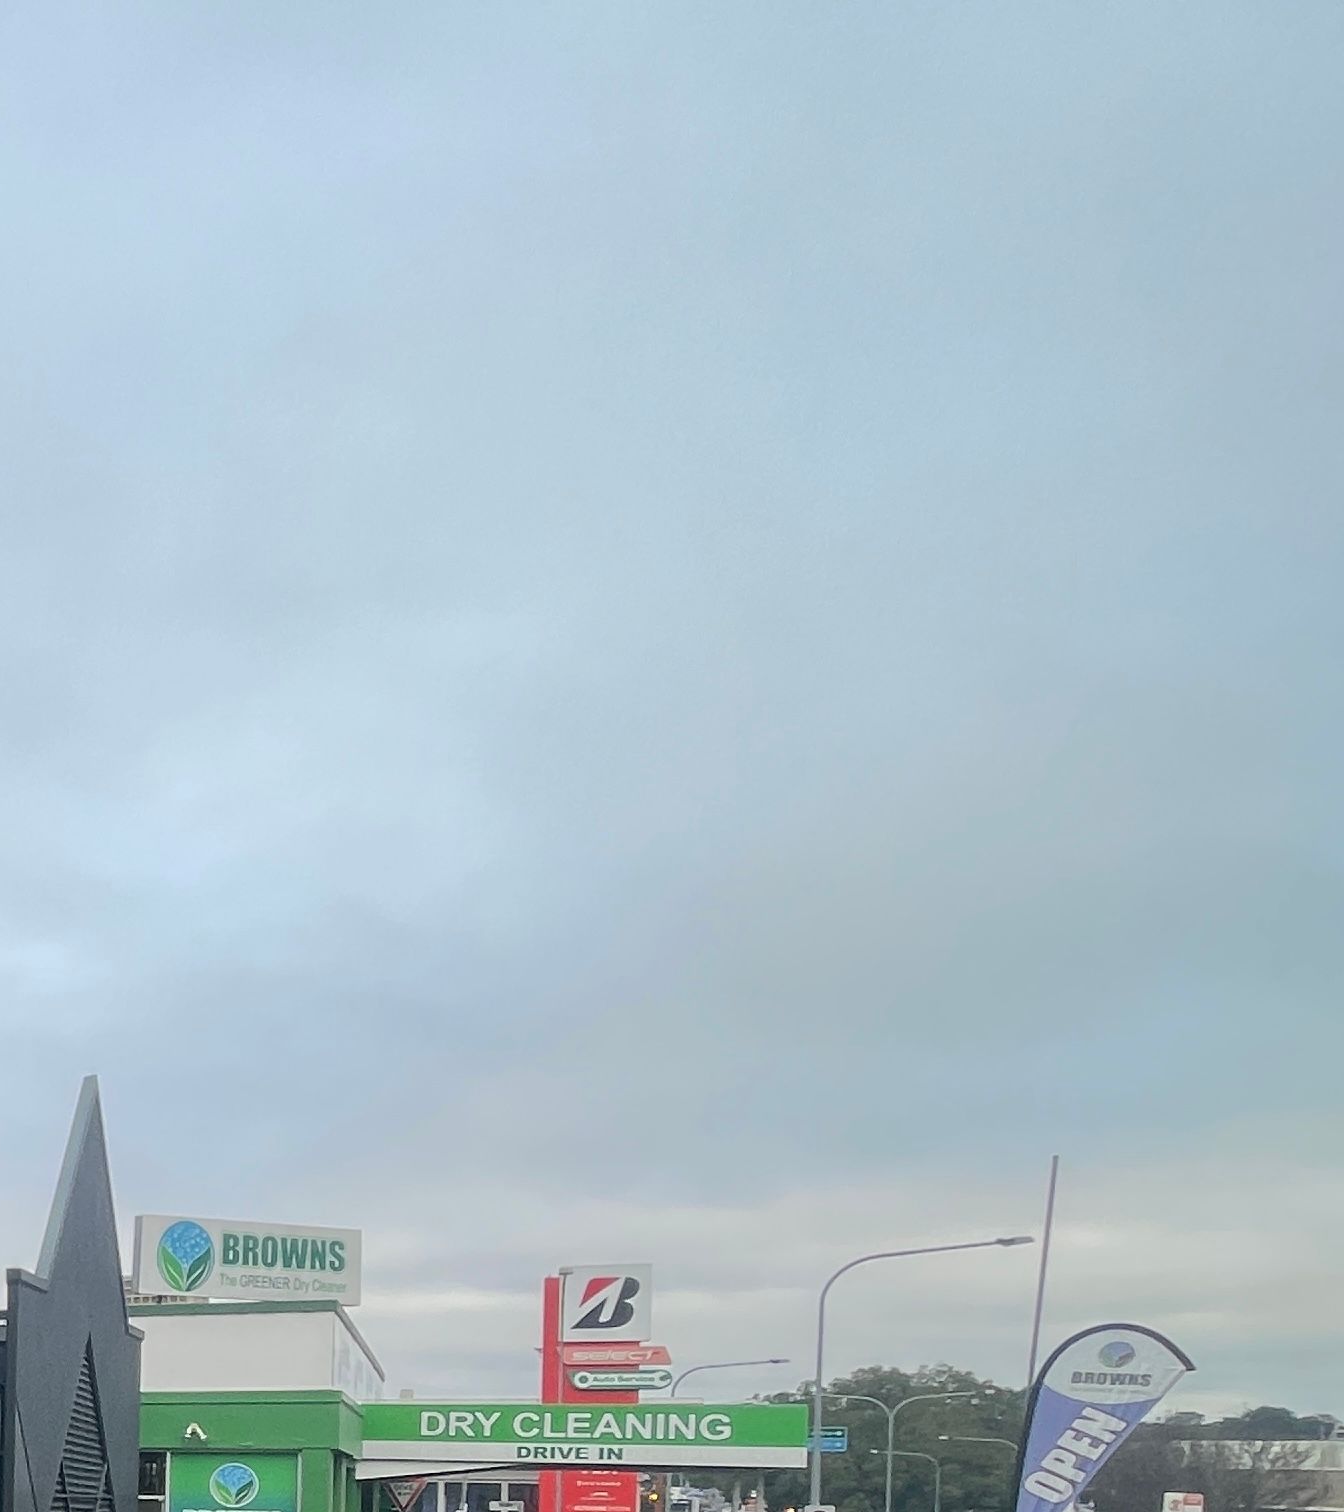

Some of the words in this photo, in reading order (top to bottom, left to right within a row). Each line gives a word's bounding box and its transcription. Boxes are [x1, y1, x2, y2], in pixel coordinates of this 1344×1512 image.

[221, 1232, 346, 1273] BROWNS
[219, 1273, 238, 1287] The
[239, 1274, 291, 1291] GREENER
[293, 1279, 310, 1294] Dry
[312, 1279, 347, 1294] Cleaner
[592, 1375, 616, 1386] Auto
[617, 1375, 656, 1383] Service
[1070, 1370, 1153, 1388] BROWNS
[419, 1410, 502, 1438] DRY
[512, 1411, 733, 1441] CLEANING
[516, 1445, 590, 1460] DRIVE
[597, 1447, 624, 1461] IN
[1024, 1405, 1128, 1504] OPEN
